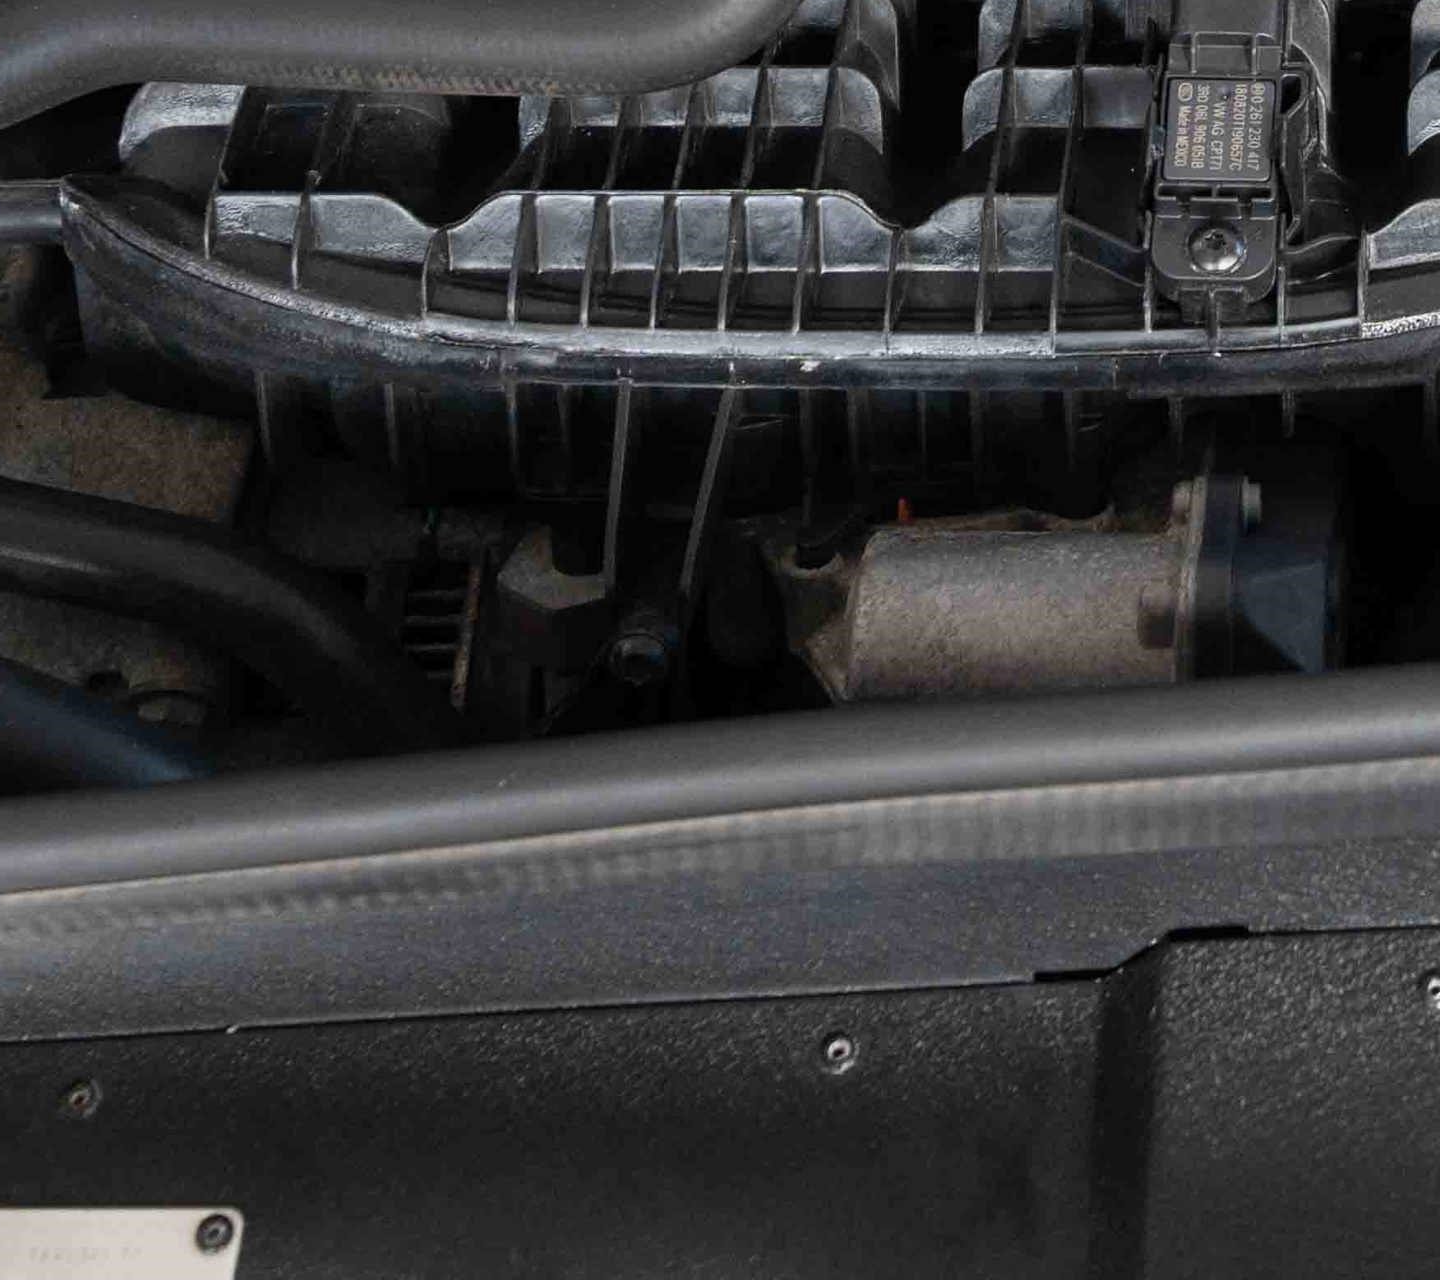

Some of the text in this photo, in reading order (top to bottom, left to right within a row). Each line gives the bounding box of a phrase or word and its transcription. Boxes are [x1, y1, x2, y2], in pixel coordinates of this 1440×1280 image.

[1213, 101, 1226, 120] VW
[1211, 121, 1225, 136] AG
[1247, 127, 1262, 149] 230
